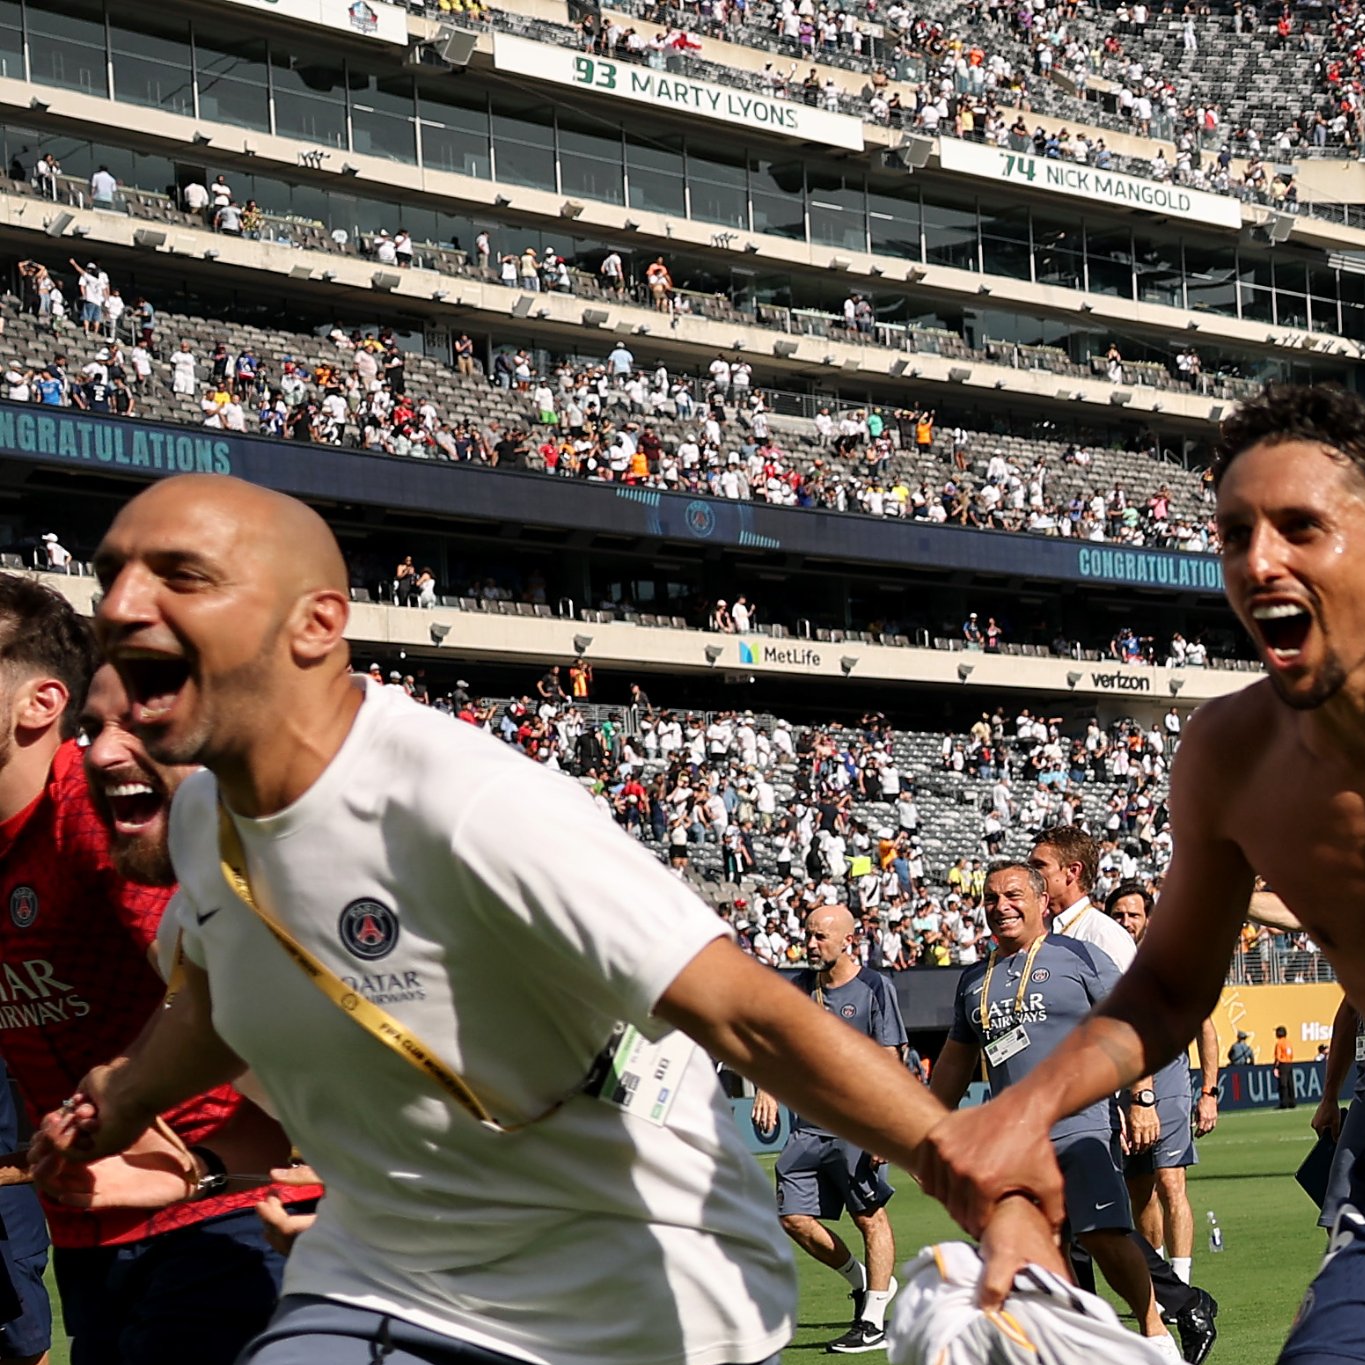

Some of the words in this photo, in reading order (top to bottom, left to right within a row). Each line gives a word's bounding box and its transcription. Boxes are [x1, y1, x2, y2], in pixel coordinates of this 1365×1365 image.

[573, 56, 617, 89] 93
[631, 71, 720, 108] MARTY
[727, 94, 798, 129] LYONS
[1000, 153, 1037, 182] 74
[1046, 165, 1090, 192] NICK
[1094, 175, 1191, 212] MANGOLD
[764, 646, 821, 666] MetLife
[1091, 670, 1150, 691] verizon
[1248, 1066, 1323, 1101] ULRA
